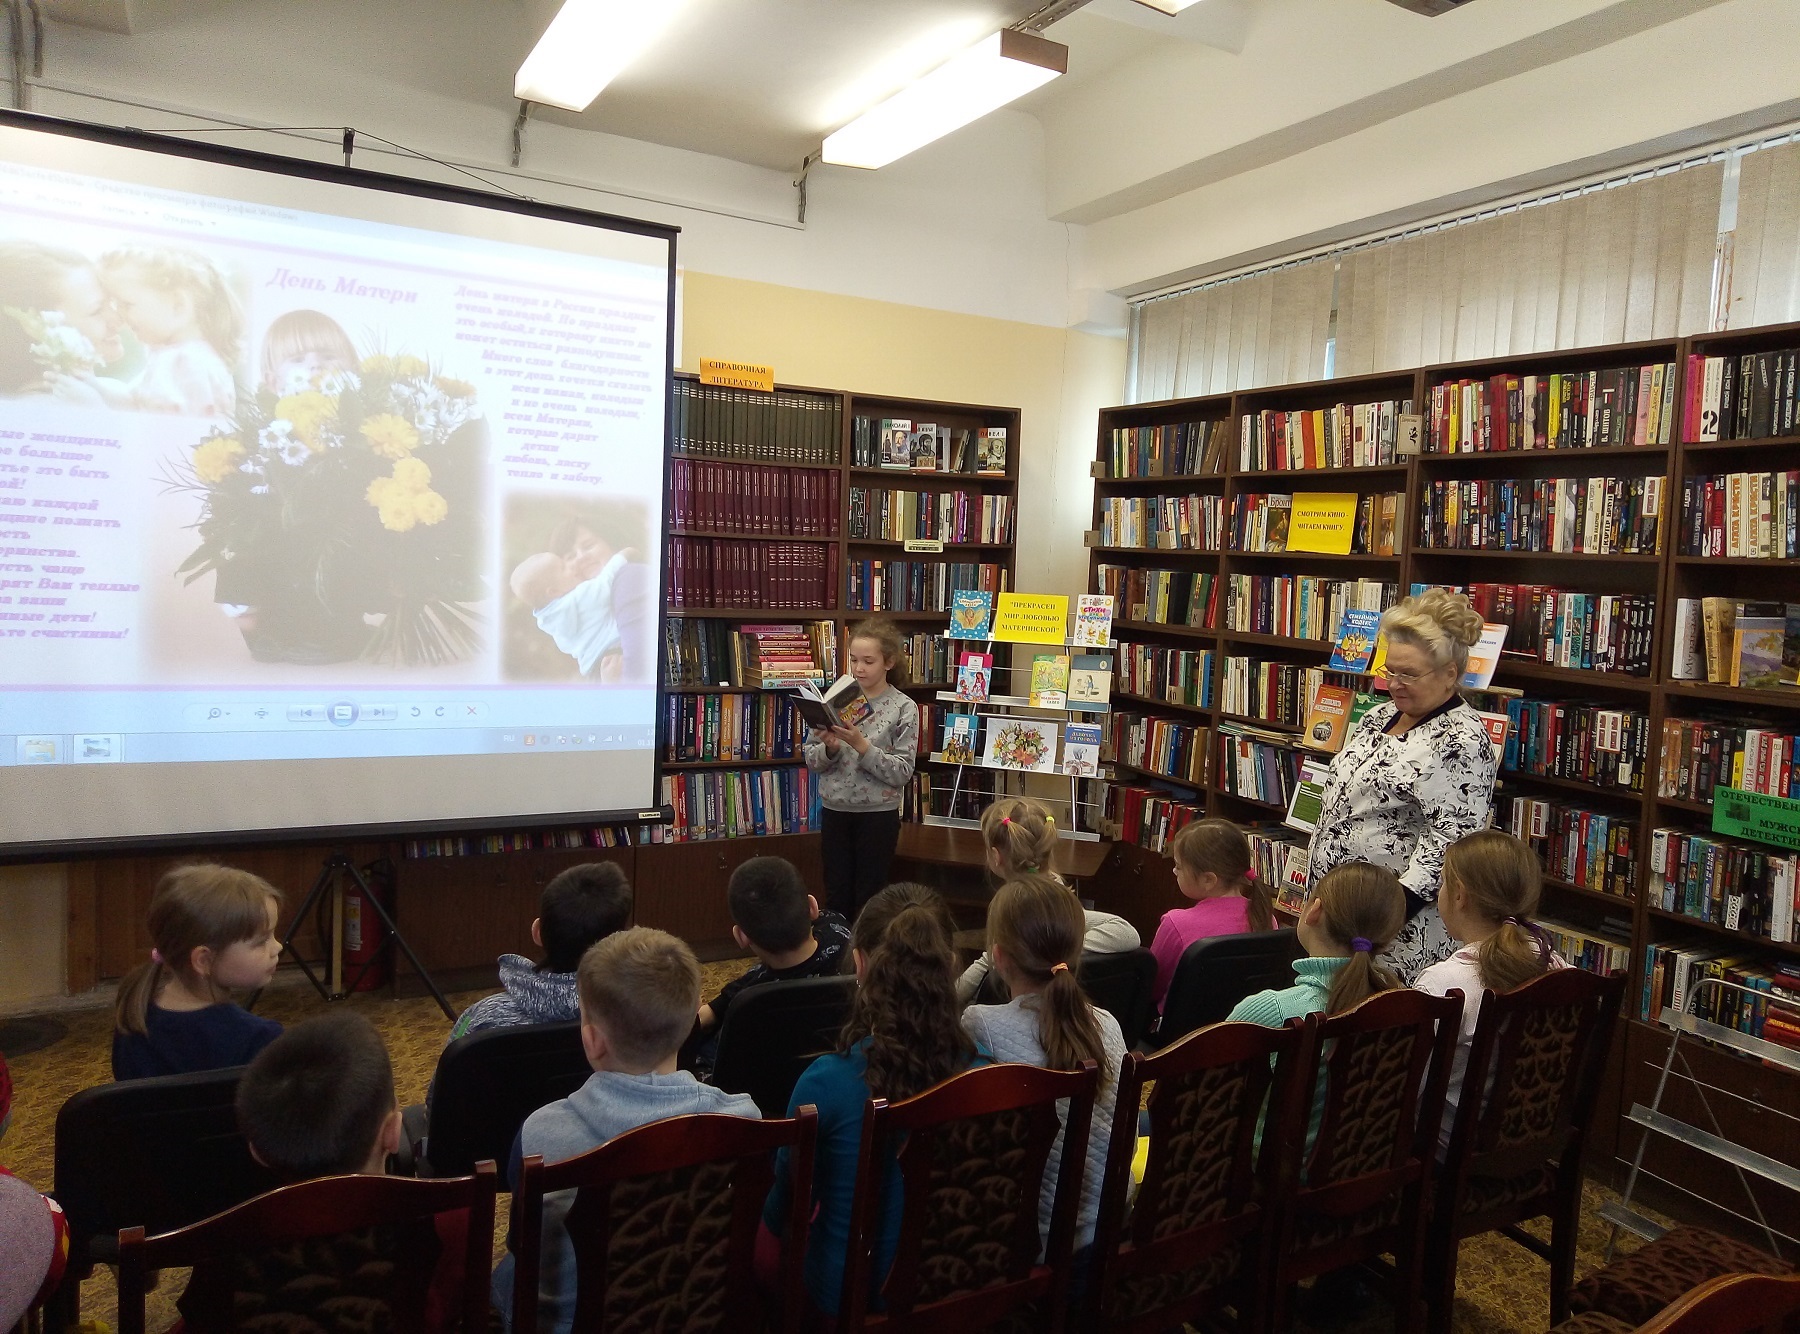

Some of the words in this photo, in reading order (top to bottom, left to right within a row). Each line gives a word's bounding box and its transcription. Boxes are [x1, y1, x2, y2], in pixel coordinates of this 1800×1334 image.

[266, 268, 326, 291] День
[334, 276, 418, 304] Матери
[454, 285, 488, 300] День
[553, 298, 596, 314] России
[598, 308, 656, 322] праздник
[455, 303, 493, 314] очень
[558, 314, 576, 326] Но
[579, 320, 637, 334] праздник
[455, 317, 476, 327] это
[540, 328, 596, 344] которому
[599, 337, 634, 348] никто
[638, 341, 652, 349] не
[455, 332, 497, 344] может
[500, 337, 552, 350] остаться
[481, 350, 522, 365] Много
[525, 357, 554, 367] слов
[561, 359, 649, 378] благодарности
[709, 361, 766, 374] СПРАВОЧНАЯ
[497, 369, 524, 378] этот
[525, 371, 554, 382] день
[559, 375, 605, 388] хочется
[607, 380, 652, 392] сказать
[710, 375, 764, 388] ЛИТЕРАТУРА
[511, 384, 540, 394] всем
[523, 400, 538, 408] не
[542, 402, 577, 412] очень
[503, 412, 532, 422] всем
[1702, 410, 1718, 435] 2
[885, 421, 907, 429] НИКОЛАЙ
[507, 427, 558, 439] которые
[561, 432, 599, 443] дарят
[19, 445, 93, 461] большое
[555, 459, 591, 470] ласку
[35, 466, 63, 476] это
[68, 465, 109, 479] быть
[507, 470, 543, 479] тепло
[1732, 478, 1740, 517] КРИСТИ
[1750, 476, 1758, 515] КРИСТИ
[32, 499, 99, 511] каждой
[41, 565, 85, 576] чаще
[38, 578, 73, 589] Вам
[1010, 601, 1056, 610] "ПРЕКРАСЕН
[1020, 614, 1059, 622] ЛЮБОВЬЮ
[1349, 613, 1378, 622] СЕМЕЙНЫЙ
[1352, 619, 1372, 627] КОДЕКС
[1001, 624, 1060, 634] МАТЕРИНСКОЙ"
[1685, 604, 1697, 675] Мураками
[1721, 790, 1800, 812] ОТЕЧЕСТВЕН
